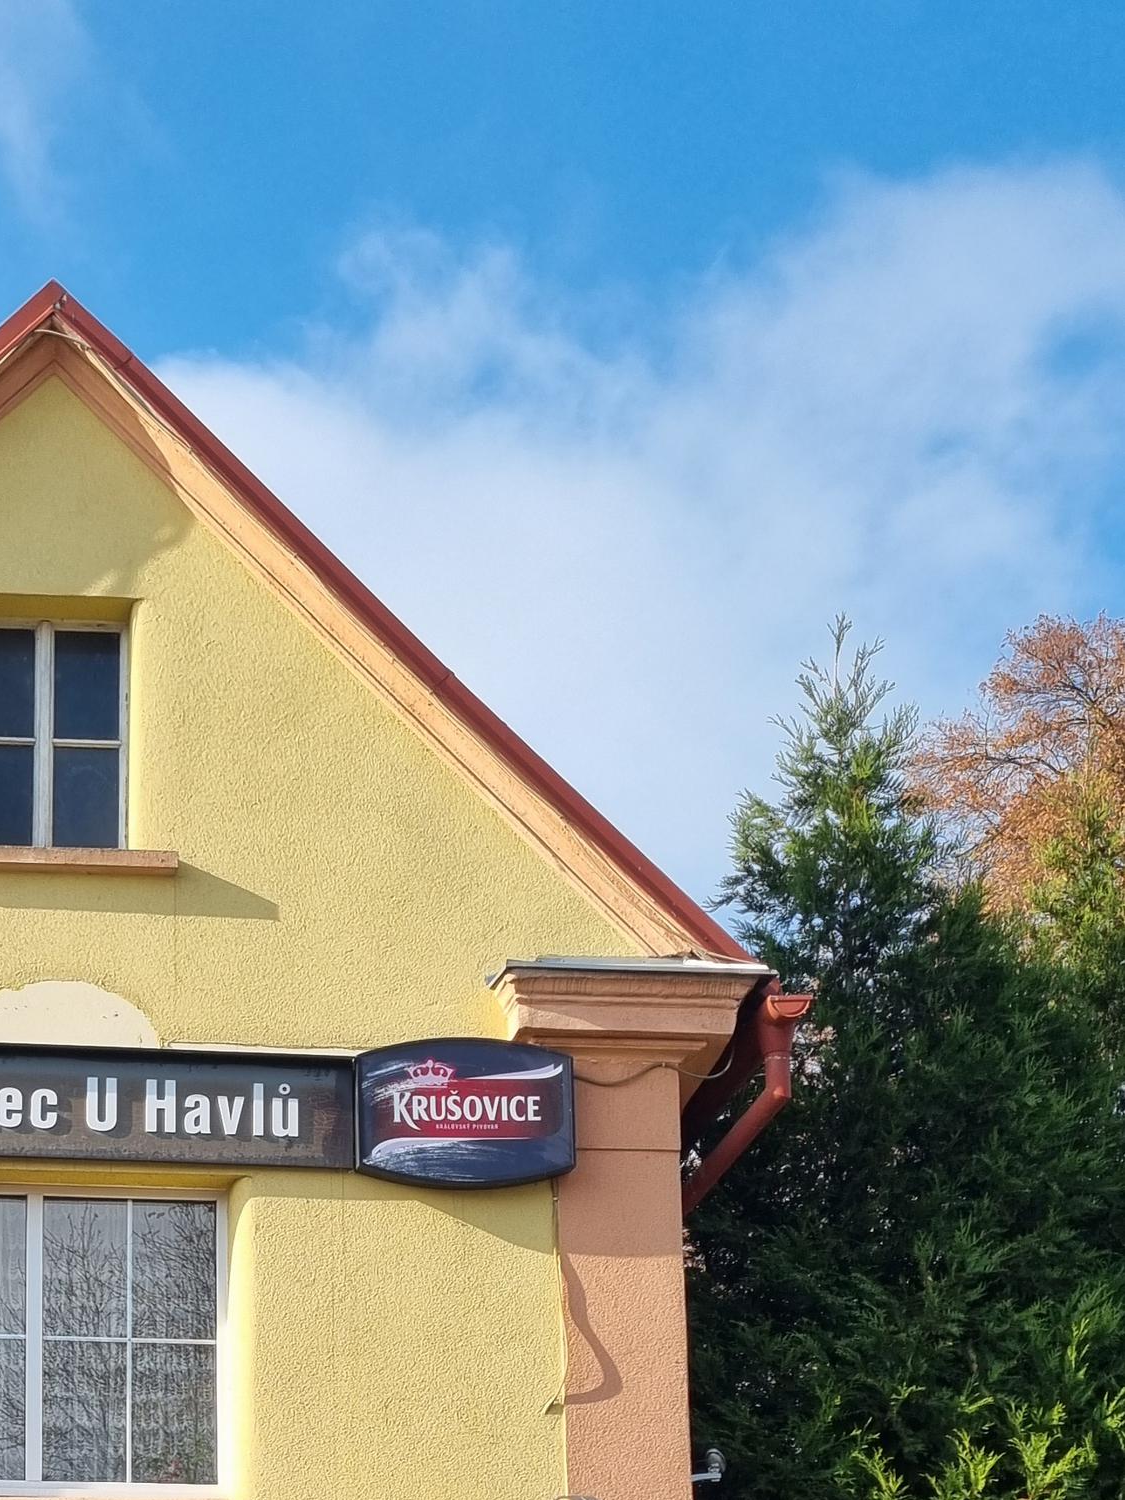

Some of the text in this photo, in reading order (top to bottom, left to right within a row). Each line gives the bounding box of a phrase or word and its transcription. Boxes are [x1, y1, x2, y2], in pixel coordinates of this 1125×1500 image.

[86, 1076, 118, 1132] U
[144, 1079, 299, 1138] Havlů
[393, 1090, 542, 1131] KRUŠOVICE
